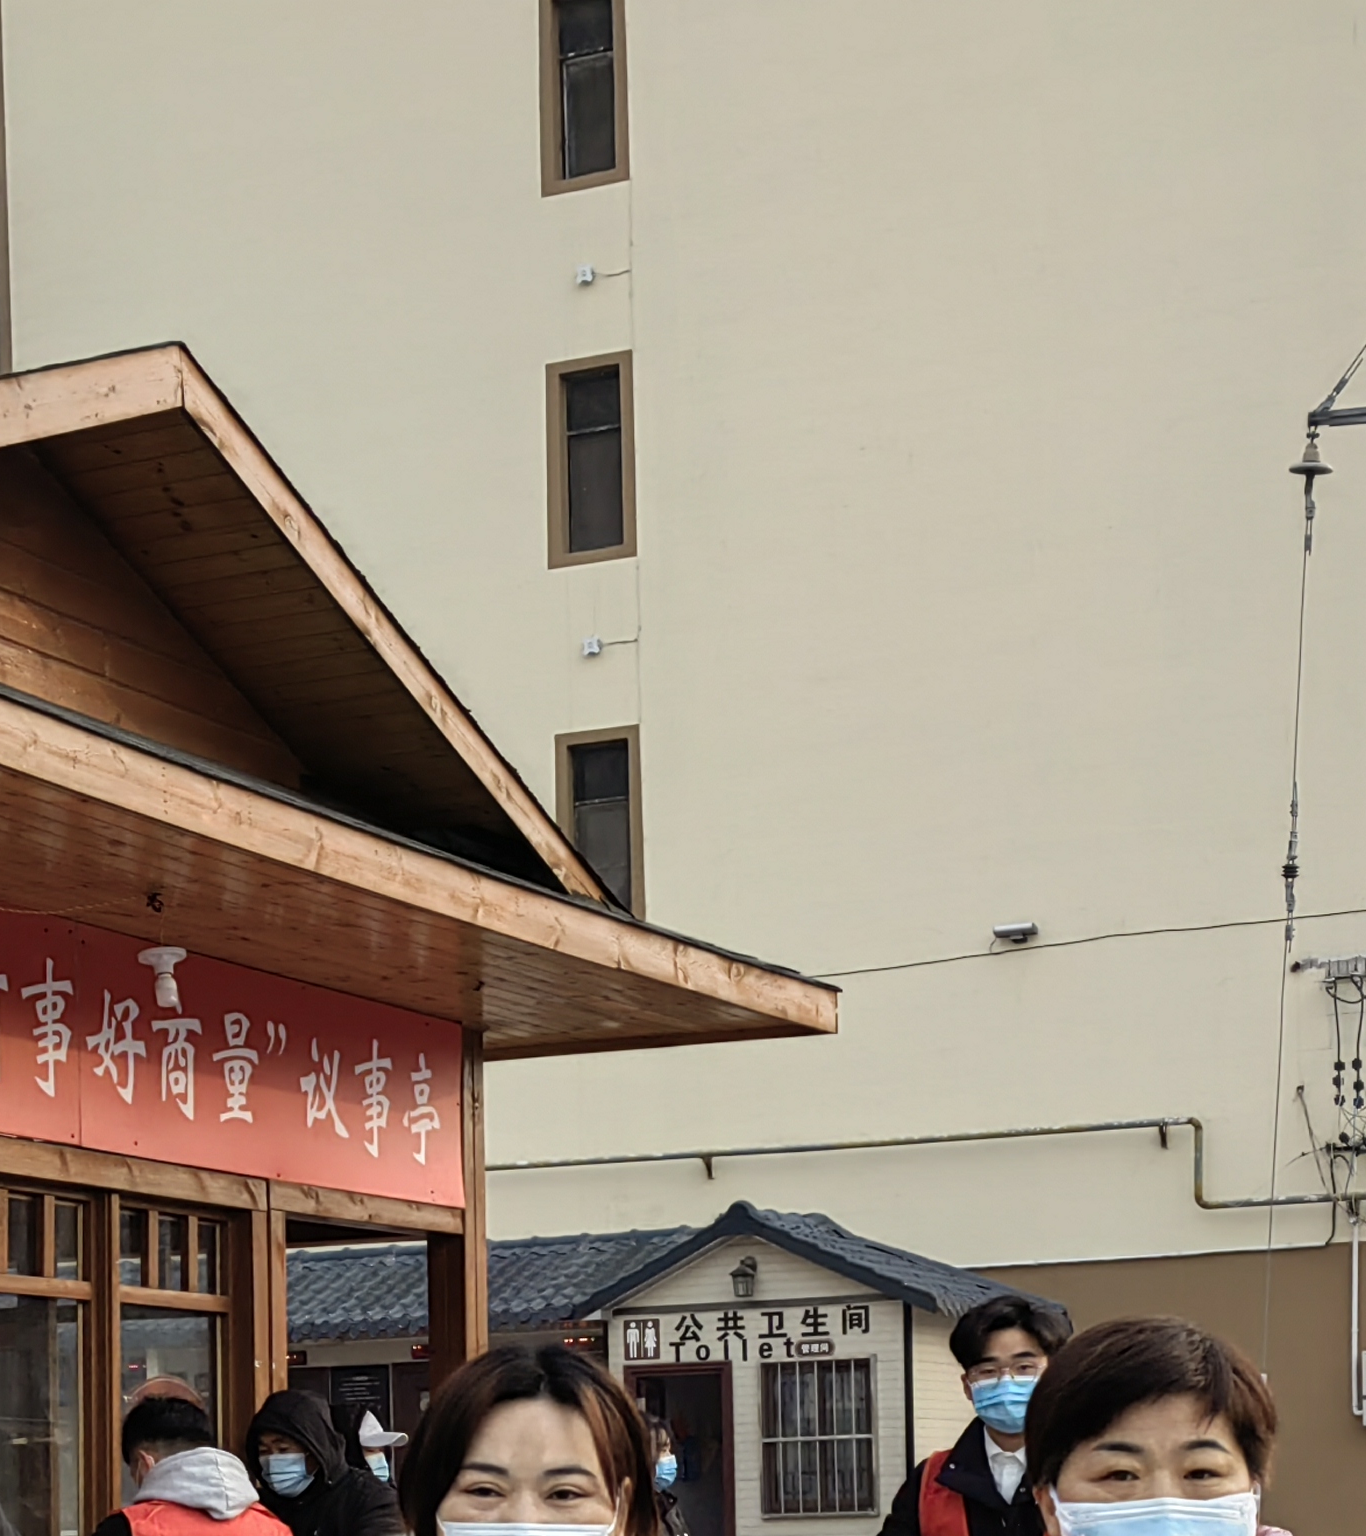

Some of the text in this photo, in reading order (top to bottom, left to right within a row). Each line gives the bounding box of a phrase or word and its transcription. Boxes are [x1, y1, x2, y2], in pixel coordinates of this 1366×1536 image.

[674, 1304, 871, 1342] 公共卫生间
